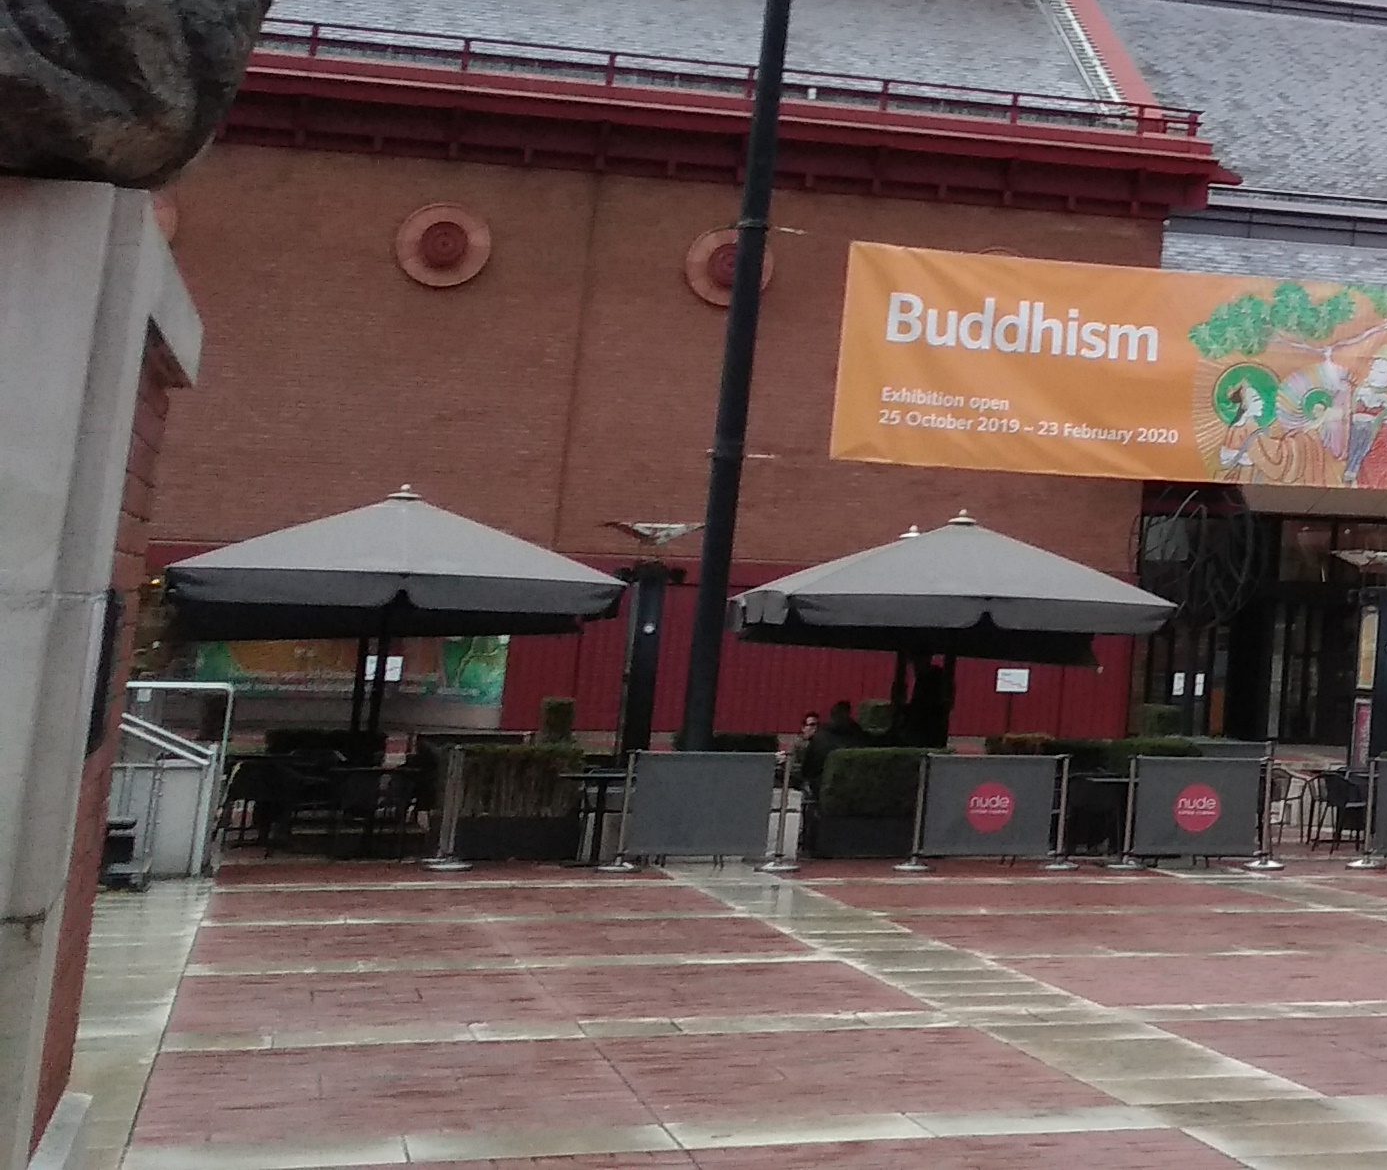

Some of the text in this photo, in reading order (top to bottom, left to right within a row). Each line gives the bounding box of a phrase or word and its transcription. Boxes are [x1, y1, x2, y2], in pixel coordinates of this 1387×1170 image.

[885, 291, 1159, 363] Buddhism
[881, 386, 1010, 412] Exhibition open
[878, 409, 901, 425] 25
[904, 411, 974, 430] October
[977, 416, 1020, 433] 2019
[1037, 421, 1059, 436] 23
[1063, 423, 1134, 445] February
[1137, 427, 1179, 444] 2020
[970, 795, 1010, 808] nude
[1178, 796, 1217, 810] nude
